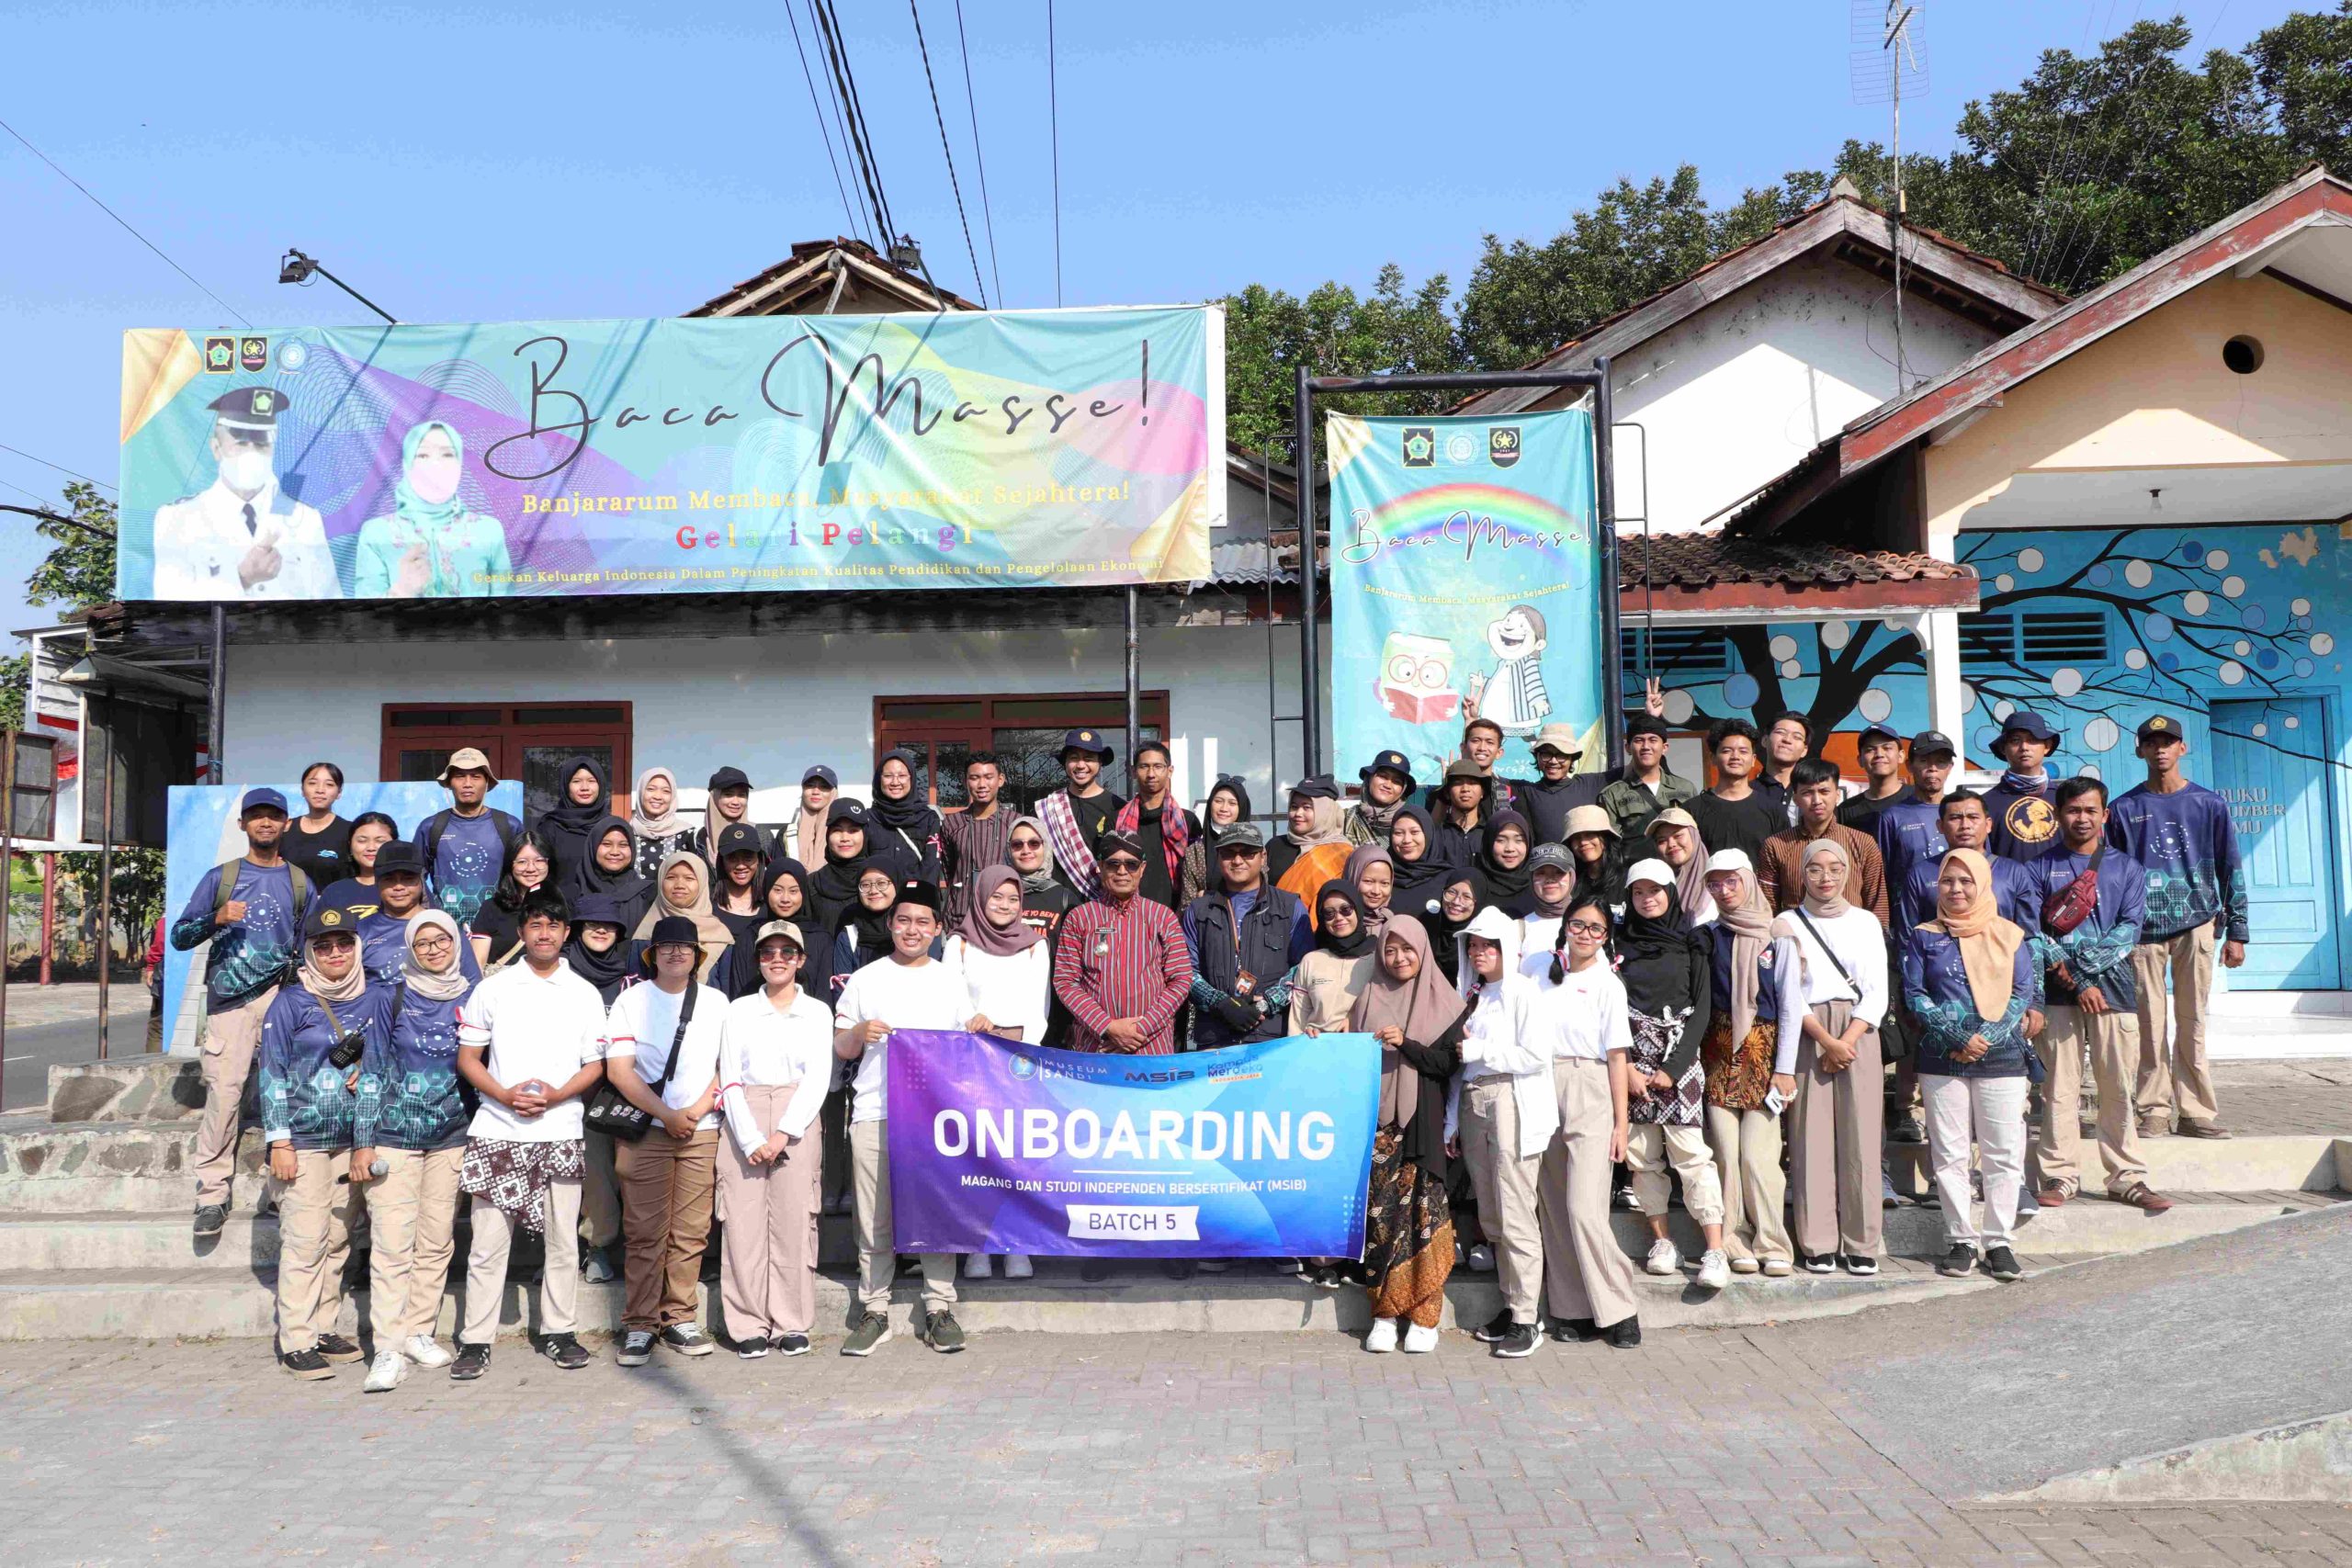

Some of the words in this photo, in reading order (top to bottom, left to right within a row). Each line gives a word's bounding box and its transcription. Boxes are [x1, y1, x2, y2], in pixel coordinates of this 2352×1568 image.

[484, 336, 739, 479] Baca
[761, 334, 1148, 467] Masse!
[522, 492, 677, 517] Banjararum
[689, 487, 819, 510] Membaca,
[994, 481, 1129, 506] Sejahtera!
[821, 520, 972, 552] Pelangi
[1340, 508, 1436, 564] Baca
[1443, 509, 1591, 561] Masse!
[473, 571, 532, 583] Gerakan
[537, 570, 600, 584] Keluarga
[605, 569, 675, 581] Indonesia
[681, 568, 725, 580] Dalam
[731, 565, 818, 580] Peningkatan
[824, 563, 884, 577] Kualitas
[889, 562, 970, 576] Pendidikan
[976, 562, 1001, 574] dan
[1007, 561, 1095, 576] Pengelolaan
[2228, 804, 2287, 818] UMBER
[1045, 1059, 1107, 1075] MUSEUM
[1207, 1055, 1259, 1071] Kampus
[1045, 1068, 1092, 1081] SANDI
[1125, 1067, 1195, 1084] MSIB
[933, 1109, 1335, 1161] ONBOARDING
[961, 1175, 1012, 1189] MAGANG
[1016, 1180, 1041, 1192] DAN
[1046, 1181, 1081, 1192] STUDI
[1085, 1182, 1165, 1194] INDEPENDEN
[1169, 1180, 1264, 1194] BERSERTIFIKAT
[1267, 1179, 1306, 1192] (MSIB)
[1089, 1213, 1157, 1231] BATCH
[1166, 1213, 1176, 1230] 5
